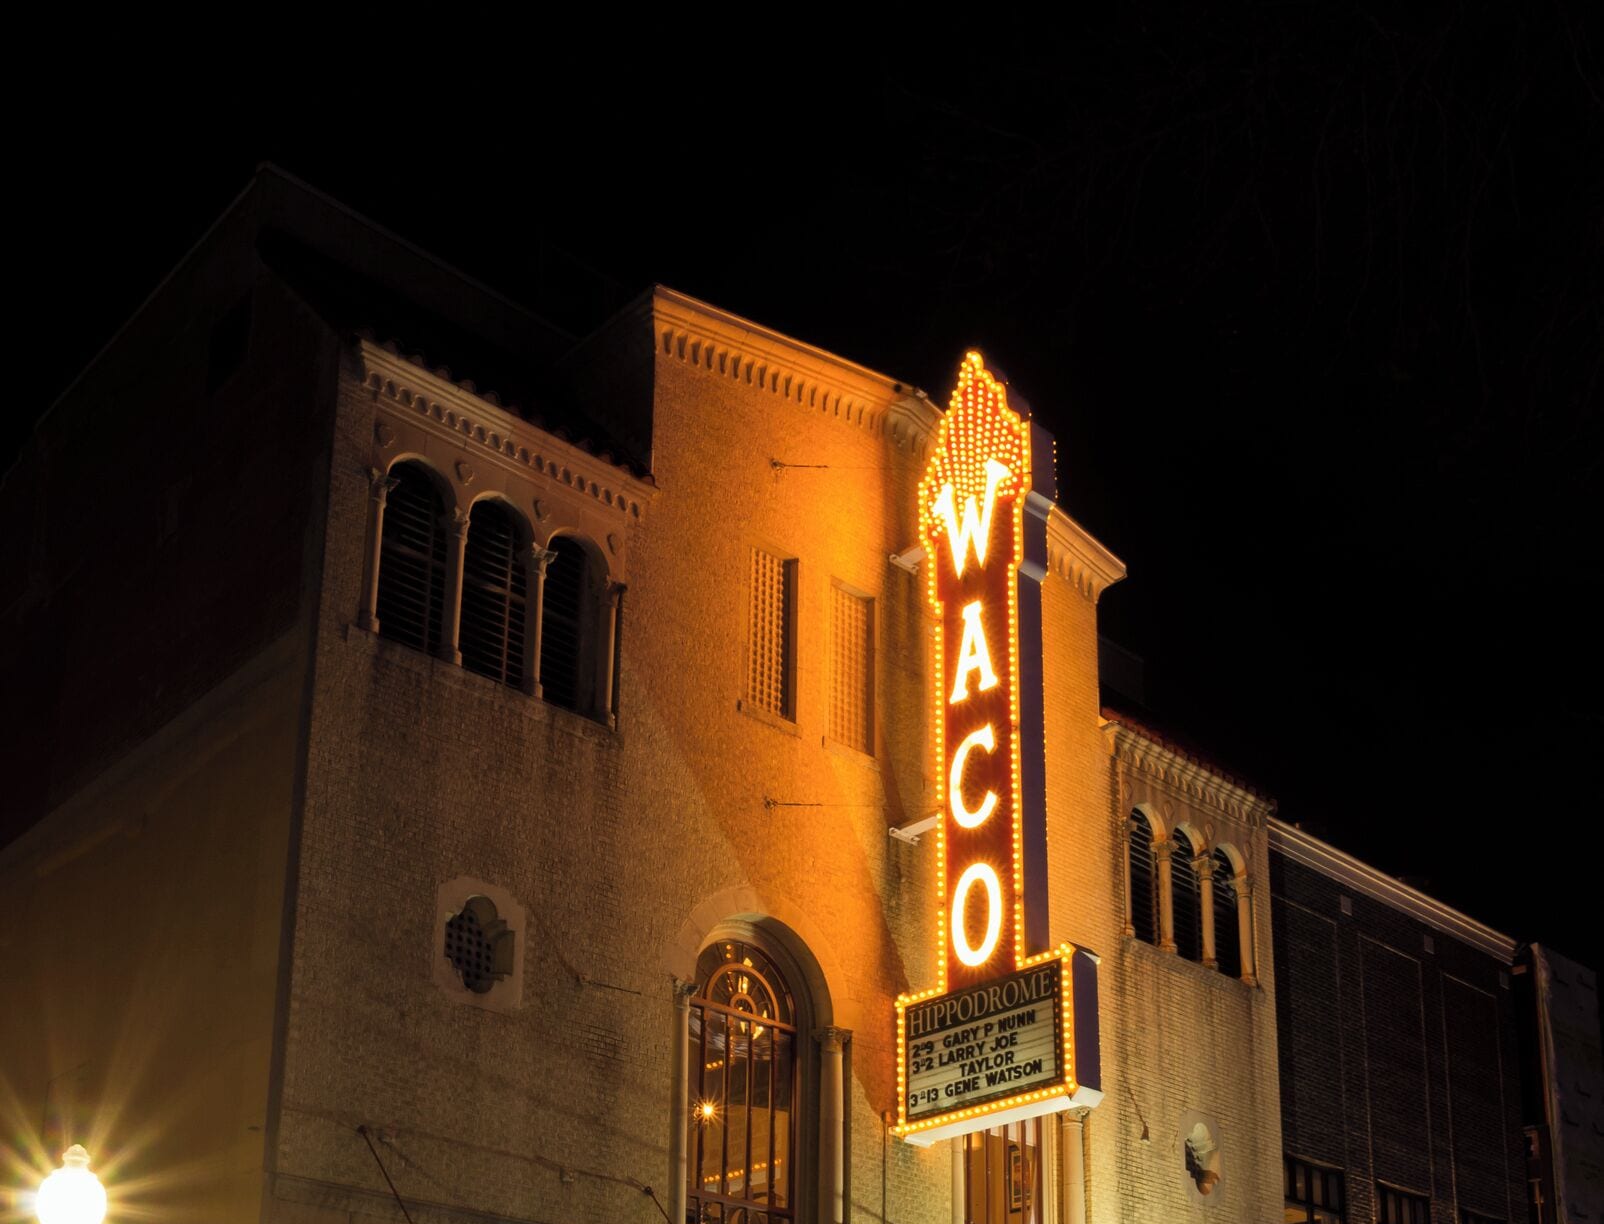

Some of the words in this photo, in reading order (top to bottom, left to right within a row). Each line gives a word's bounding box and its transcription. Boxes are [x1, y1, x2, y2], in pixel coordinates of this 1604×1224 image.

[932, 458, 1011, 967] WACO
[909, 970, 1053, 1036] HIPPODROME
[943, 1026, 979, 1048] GARY
[984, 1022, 994, 1035] P
[998, 1009, 1036, 1031] NUNN
[939, 1042, 985, 1067] LARRY
[990, 1032, 1019, 1052] JOE
[959, 1051, 1015, 1077] TAYLOR
[945, 1077, 980, 1098] GENE
[985, 1059, 1043, 1086] WATSON
